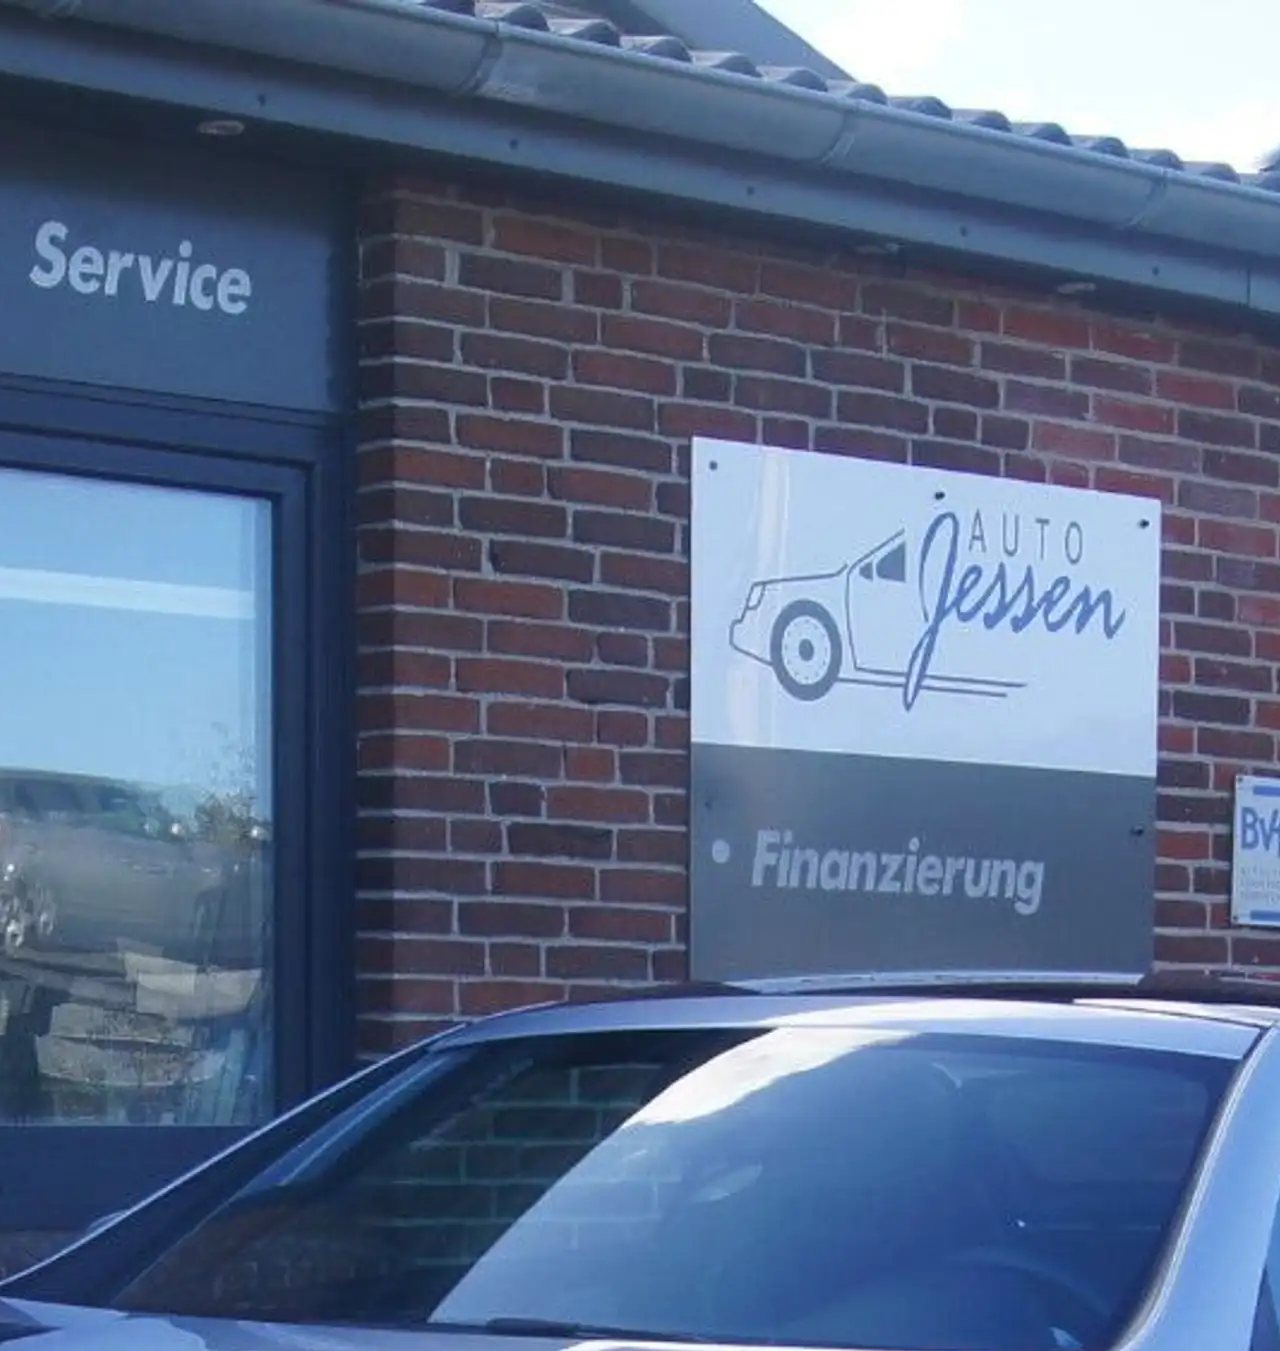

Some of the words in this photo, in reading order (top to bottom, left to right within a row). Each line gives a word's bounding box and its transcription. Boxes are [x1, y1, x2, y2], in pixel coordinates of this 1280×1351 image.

[29, 220, 252, 314] Service
[969, 508, 1084, 562] AUTO
[902, 511, 1126, 711] Jessen
[751, 829, 1045, 915] Finanzierung
